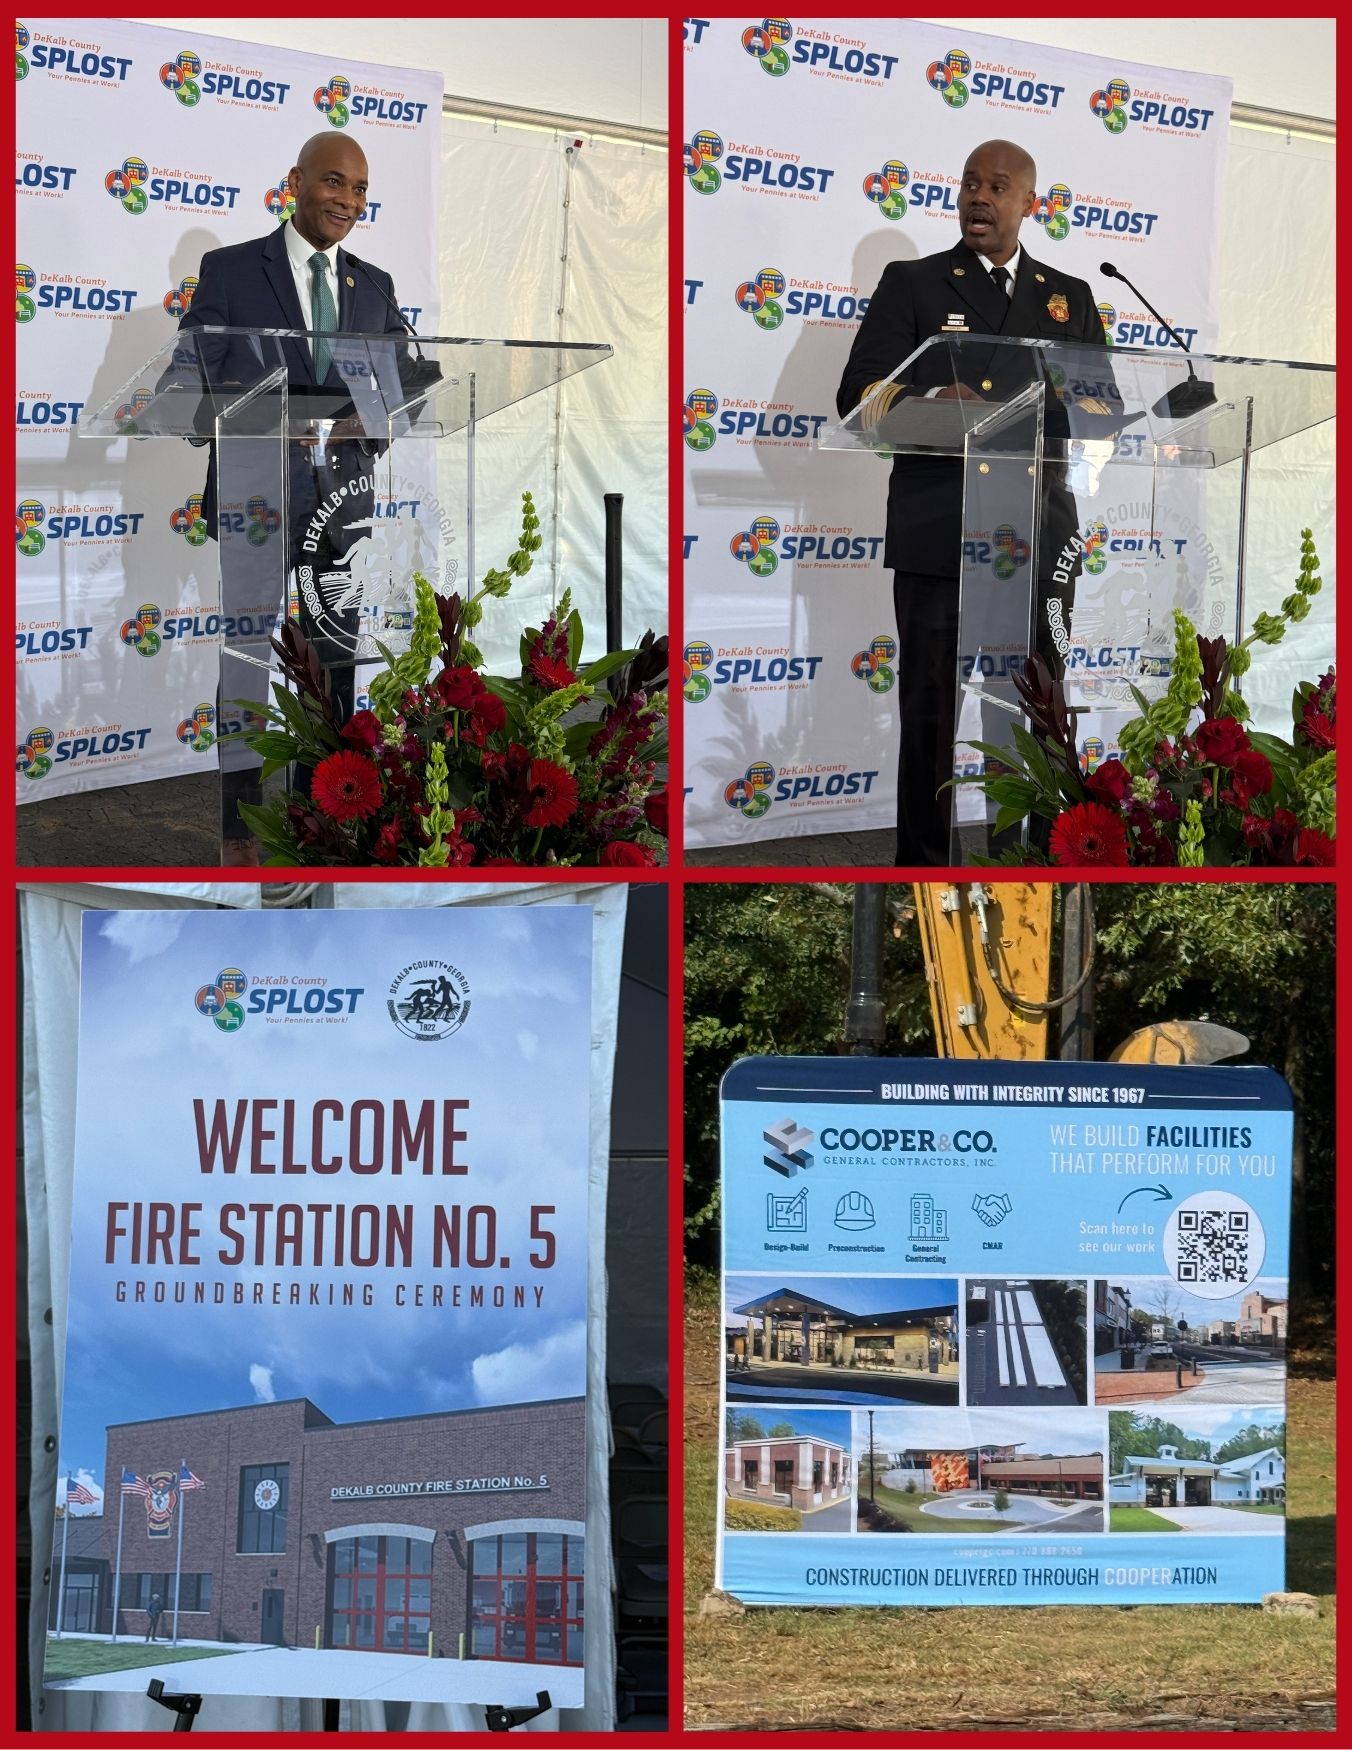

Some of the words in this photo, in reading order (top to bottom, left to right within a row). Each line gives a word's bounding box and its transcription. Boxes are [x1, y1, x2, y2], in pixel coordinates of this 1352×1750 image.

[33, 32, 67, 46] DeKalb
[69, 39, 101, 53] County
[796, 26, 831, 41] DeKalb
[833, 34, 866, 49] County
[30, 44, 132, 80] SPLOST
[792, 40, 899, 79] SPLOST
[974, 60, 1005, 73] DeKalb
[1007, 67, 1036, 80] County
[48, 72, 63, 80] Your
[65, 74, 91, 84] Pennies
[100, 80, 120, 88] Work!
[204, 62, 234, 72] DeKalb
[236, 66, 263, 79] County
[809, 68, 824, 77] Your
[827, 71, 853, 82] Pennies
[864, 78, 884, 87] Work!
[202, 72, 290, 104] SPLOST
[353, 85, 379, 95] DeKalb
[380, 89, 405, 100] County
[971, 72, 1065, 108] SPLOST
[1134, 89, 1161, 99] DeKalb
[1163, 94, 1189, 105] County
[351, 96, 428, 124] SPLOST
[1129, 100, 1214, 131] SPLOST
[16, 152, 44, 163] ounty
[728, 142, 764, 156] DeKalb
[766, 149, 800, 163] County
[16, 163, 77, 190] OST
[152, 167, 182, 178] DeKalb
[184, 172, 212, 183] County
[724, 155, 834, 193] SPLOST
[912, 171, 944, 183] DeKalb
[150, 178, 240, 209] SPLOST
[741, 185, 758, 193] Your
[759, 187, 787, 197] Pennies
[798, 193, 819, 201] Work!
[1075, 193, 1104, 204] DeKalb
[1105, 198, 1132, 209] County
[1072, 205, 1158, 236] SPLOST
[40, 273, 72, 284] DeKalb
[75, 276, 107, 287] County
[789, 278, 823, 290] DeKalb
[826, 283, 859, 295] County
[38, 285, 137, 312] SPLOST
[786, 291, 870, 320] SPLOS
[1120, 312, 1145, 321] DeKalb
[1115, 323, 1198, 348] SPLOST
[19, 391, 52, 400] County
[722, 398, 757, 409] DeKalb
[760, 401, 794, 413] County
[16, 402, 84, 425] LOST
[718, 411, 827, 438] SPLOST
[49, 505, 81, 514] DeKalb
[83, 505, 114, 514] County
[302, 491, 343, 552] DEKALB
[349, 474, 408, 496] COUNTY
[47, 513, 144, 538] SPLOST
[784, 525, 817, 533] DeKalb
[820, 525, 853, 535] County
[780, 537, 884, 560] SPLOST
[164, 608, 193, 616] DeKalb
[29, 621, 61, 630] County
[16, 627, 93, 654] PLOST
[717, 648, 753, 656] DeKalb
[755, 647, 789, 656] County
[714, 657, 823, 684] SPLOST
[58, 728, 89, 739] DeKalb
[91, 723, 122, 736] County
[54, 728, 151, 762] SPLOST
[779, 766, 813, 776] DeKalb
[815, 764, 847, 774] County
[774, 771, 878, 801] SPLOST
[252, 975, 289, 986] DeKalb
[291, 976, 328, 987] County
[389, 967, 410, 994] DEKALB
[412, 960, 445, 970] COUNTY
[446, 965, 470, 994] GEORGIA
[247, 988, 364, 1014] SPLOST
[881, 1083, 950, 1100] BUILDING
[953, 1085, 989, 1100] WITH
[992, 1086, 1064, 1102] INTEGRITY
[1067, 1087, 1109, 1103] SINCE
[1112, 1088, 1145, 1104] 1967
[193, 1098, 469, 1175] WELCOME
[1050, 1124, 1077, 1146] WE
[1084, 1124, 1139, 1147] BUILD
[1147, 1126, 1252, 1148] FACILITIES
[824, 1156, 876, 1165] GENERAL
[882, 1157, 969, 1167] CONTRACTORS,
[974, 1159, 996, 1167] INC.
[1050, 1152, 1098, 1174] THAT
[1102, 1153, 1188, 1175] PERFORM
[1196, 1154, 1230, 1175] FOR
[1238, 1155, 1276, 1177] YOU
[105, 1202, 202, 1265] FIRE
[218, 1204, 413, 1267] STATION
[433, 1205, 510, 1268] NO.
[530, 1206, 556, 1269] 5
[1079, 1222, 1108, 1234] Scan
[1112, 1222, 1138, 1234] here
[1142, 1222, 1154, 1234] to
[764, 1242, 809, 1251] Design-Build
[828, 1244, 885, 1252] Preconstruction
[912, 1244, 939, 1252] General
[1079, 1242, 1101, 1252] see
[1104, 1243, 1122, 1252] our
[1126, 1241, 1155, 1253] work
[905, 1254, 946, 1264] Contracting
[116, 1281, 373, 1306] GROUNDBREAKING
[396, 1285, 544, 1308] CEREMONY
[331, 1485, 373, 1497] DEKALB
[376, 1482, 423, 1495] COUNTY
[426, 1481, 452, 1492] FIRE
[456, 1477, 511, 1490] STATION
[514, 1476, 536, 1487] No.
[540, 1475, 547, 1486] 5
[806, 1568, 928, 1586] CONSTRUCTION
[935, 1568, 1017, 1586] DELIVERED
[1022, 1568, 1098, 1586] THROUGH
[1104, 1567, 1217, 1586] COOPERATION
